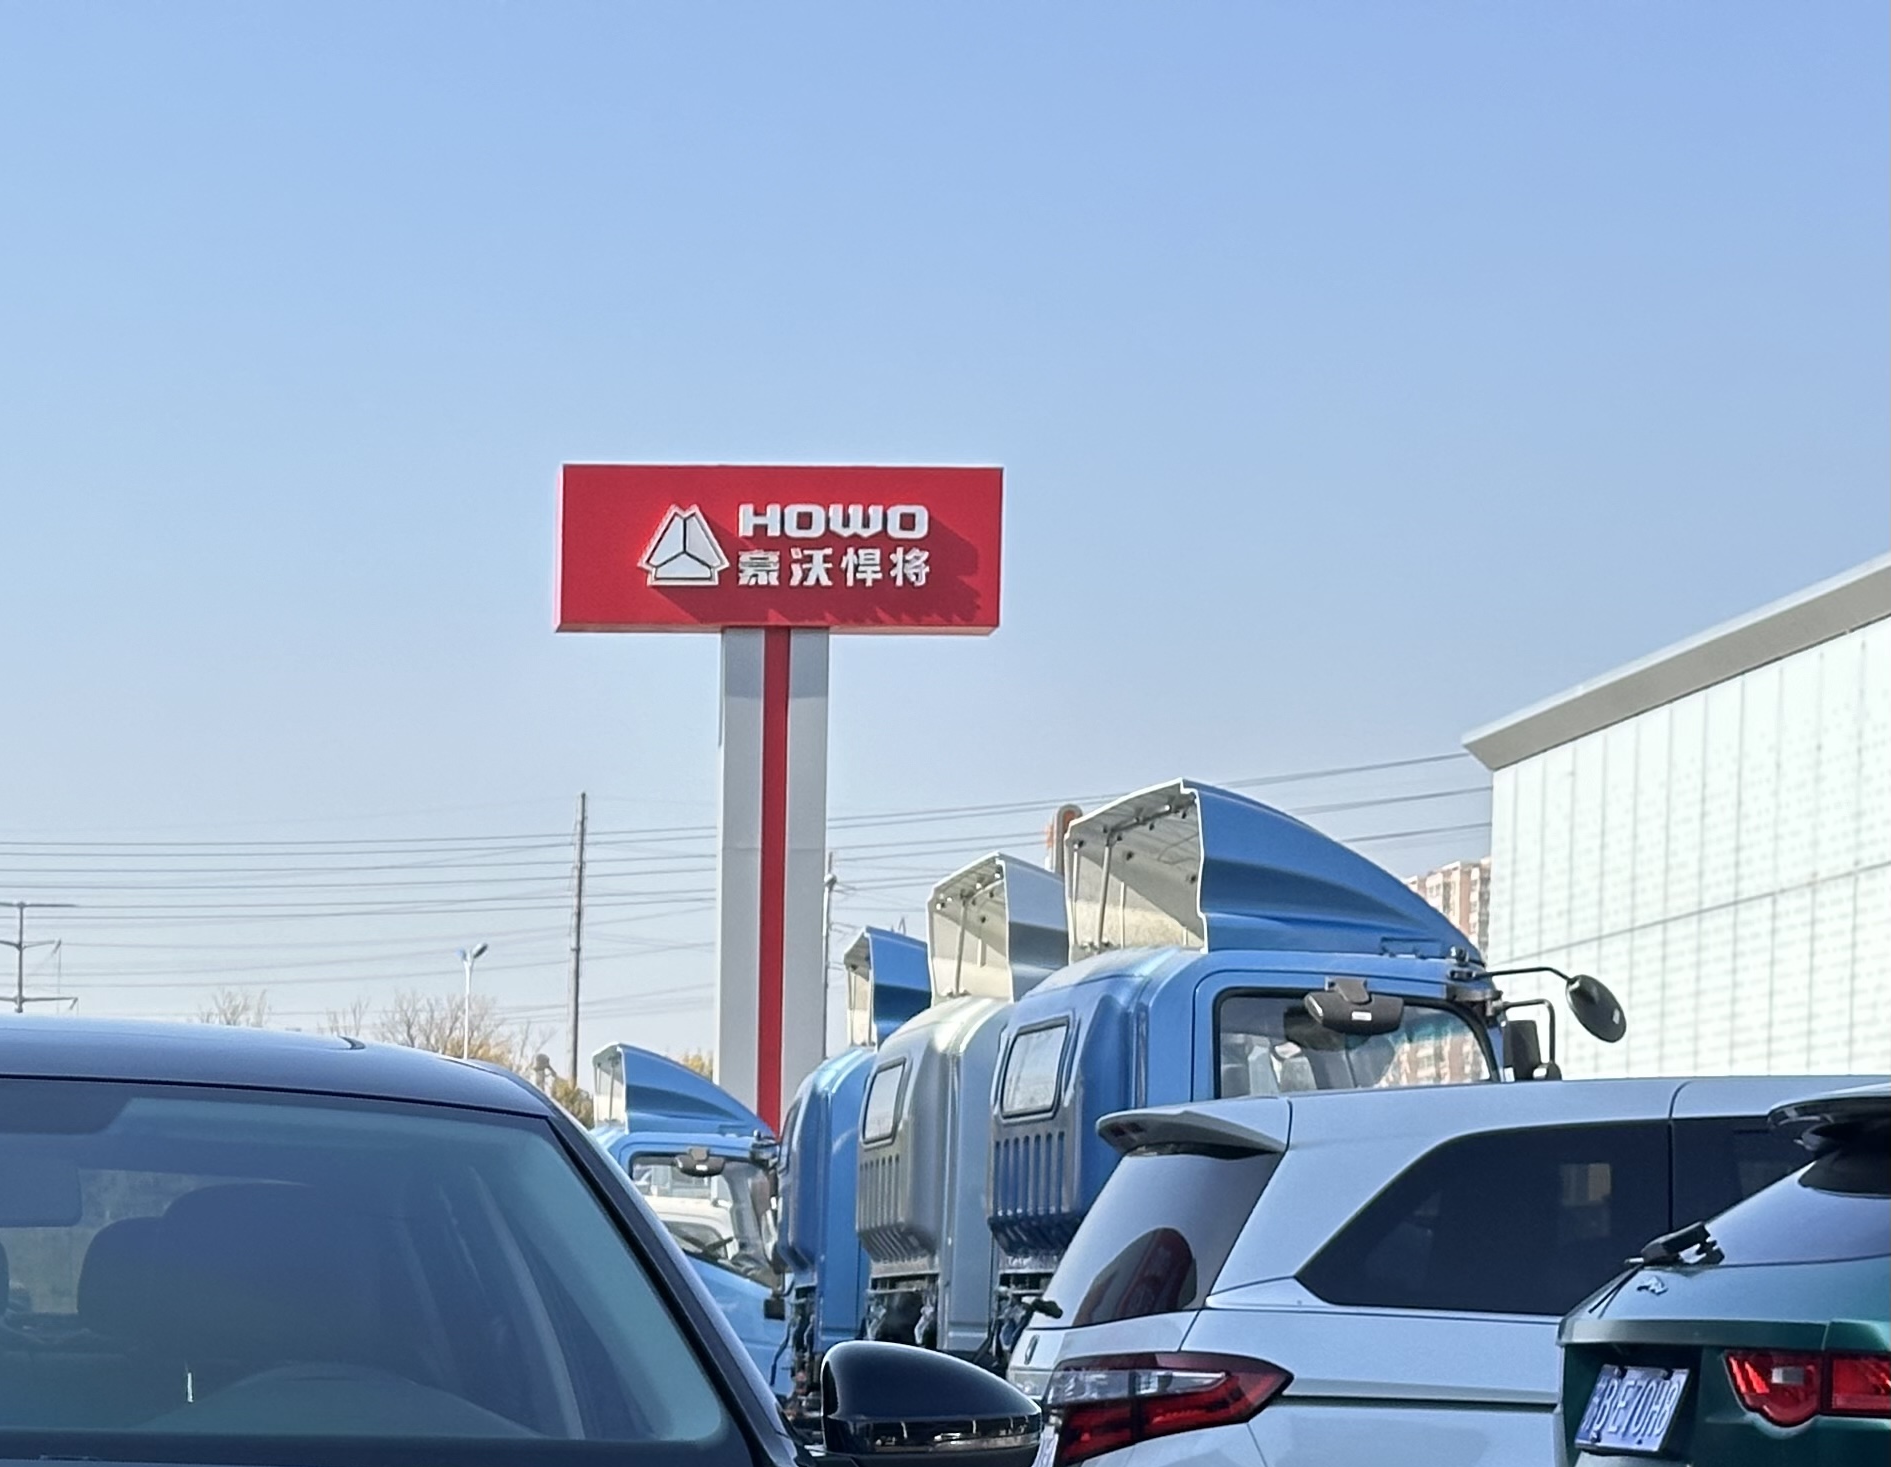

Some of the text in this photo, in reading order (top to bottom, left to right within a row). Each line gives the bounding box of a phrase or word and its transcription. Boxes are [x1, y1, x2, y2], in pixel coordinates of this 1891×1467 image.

[737, 503, 929, 540] HOWO
[737, 547, 930, 587] 豪沃悍将
